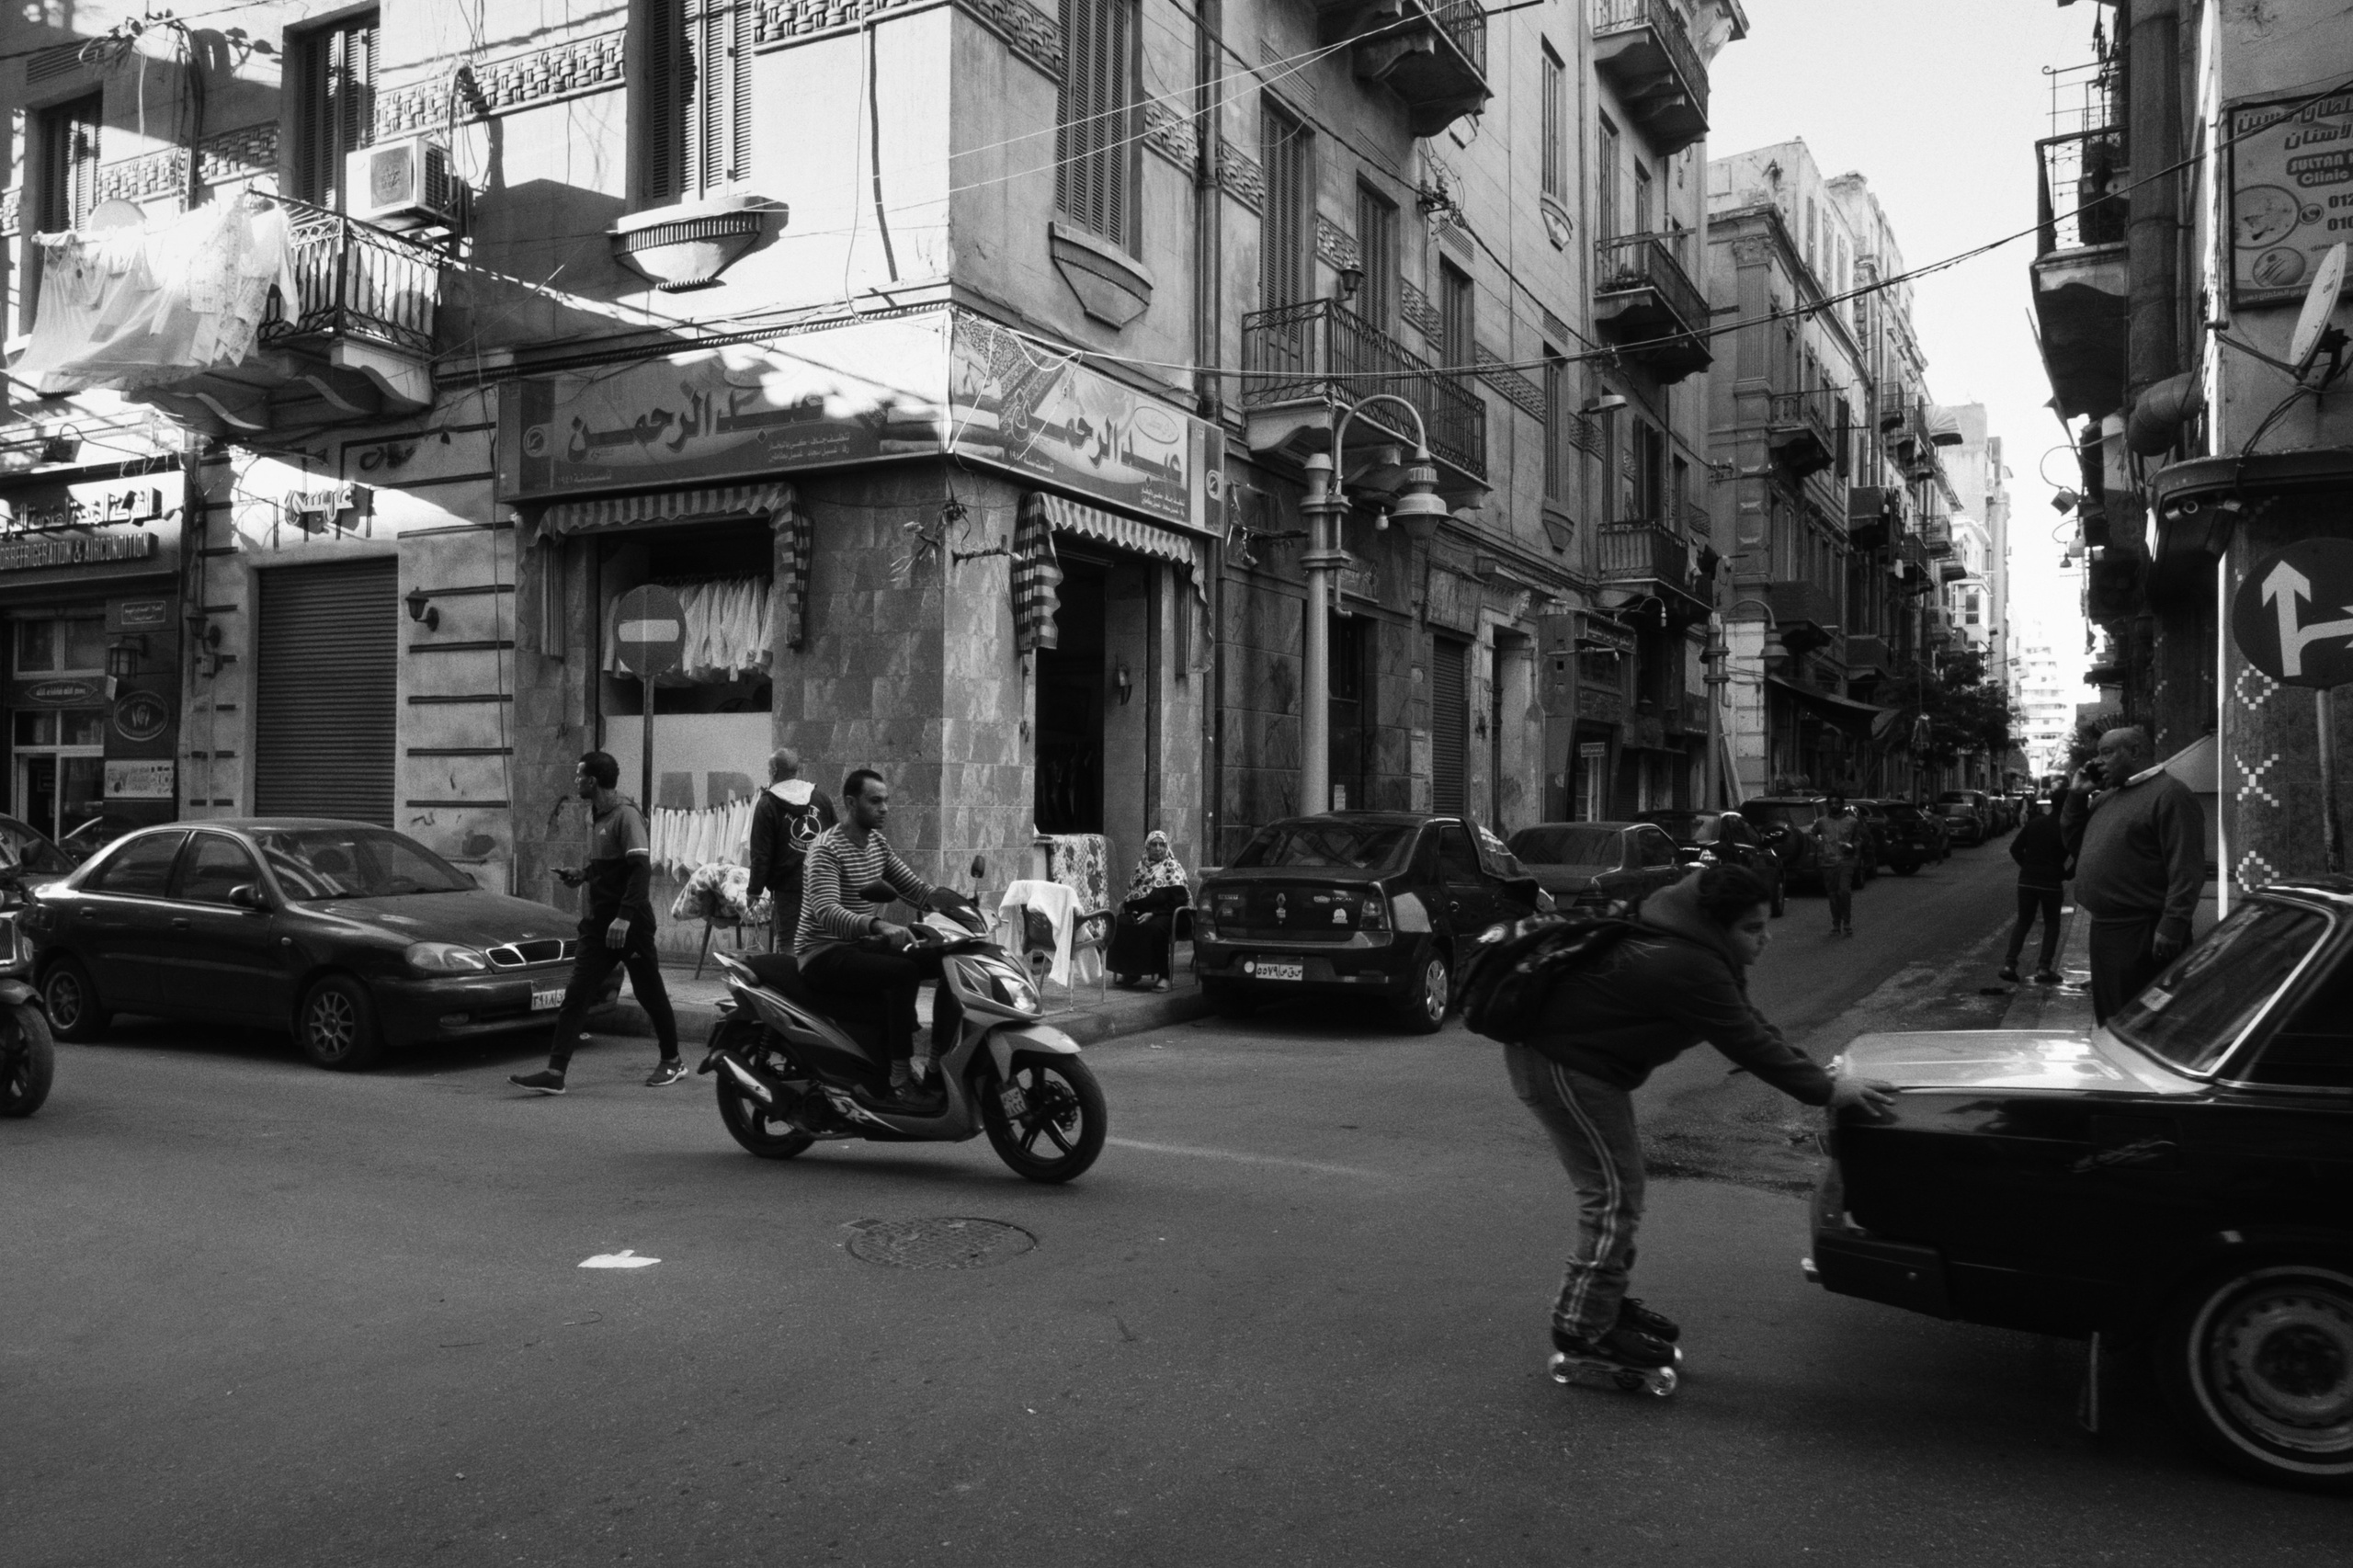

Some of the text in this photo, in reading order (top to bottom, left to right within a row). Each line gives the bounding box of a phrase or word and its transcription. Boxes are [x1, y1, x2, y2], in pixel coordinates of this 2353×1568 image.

[2290, 153, 2345, 172] SULTAN
[2301, 168, 2350, 184] Clinic
[568, 389, 824, 463] عبد الرحمن
[1011, 388, 1119, 469] الرحمن
[1120, 429, 1182, 487] عبد
[109, 486, 155, 525] الشركة
[1256, 966, 1279, 977] ٥٥٧٩
